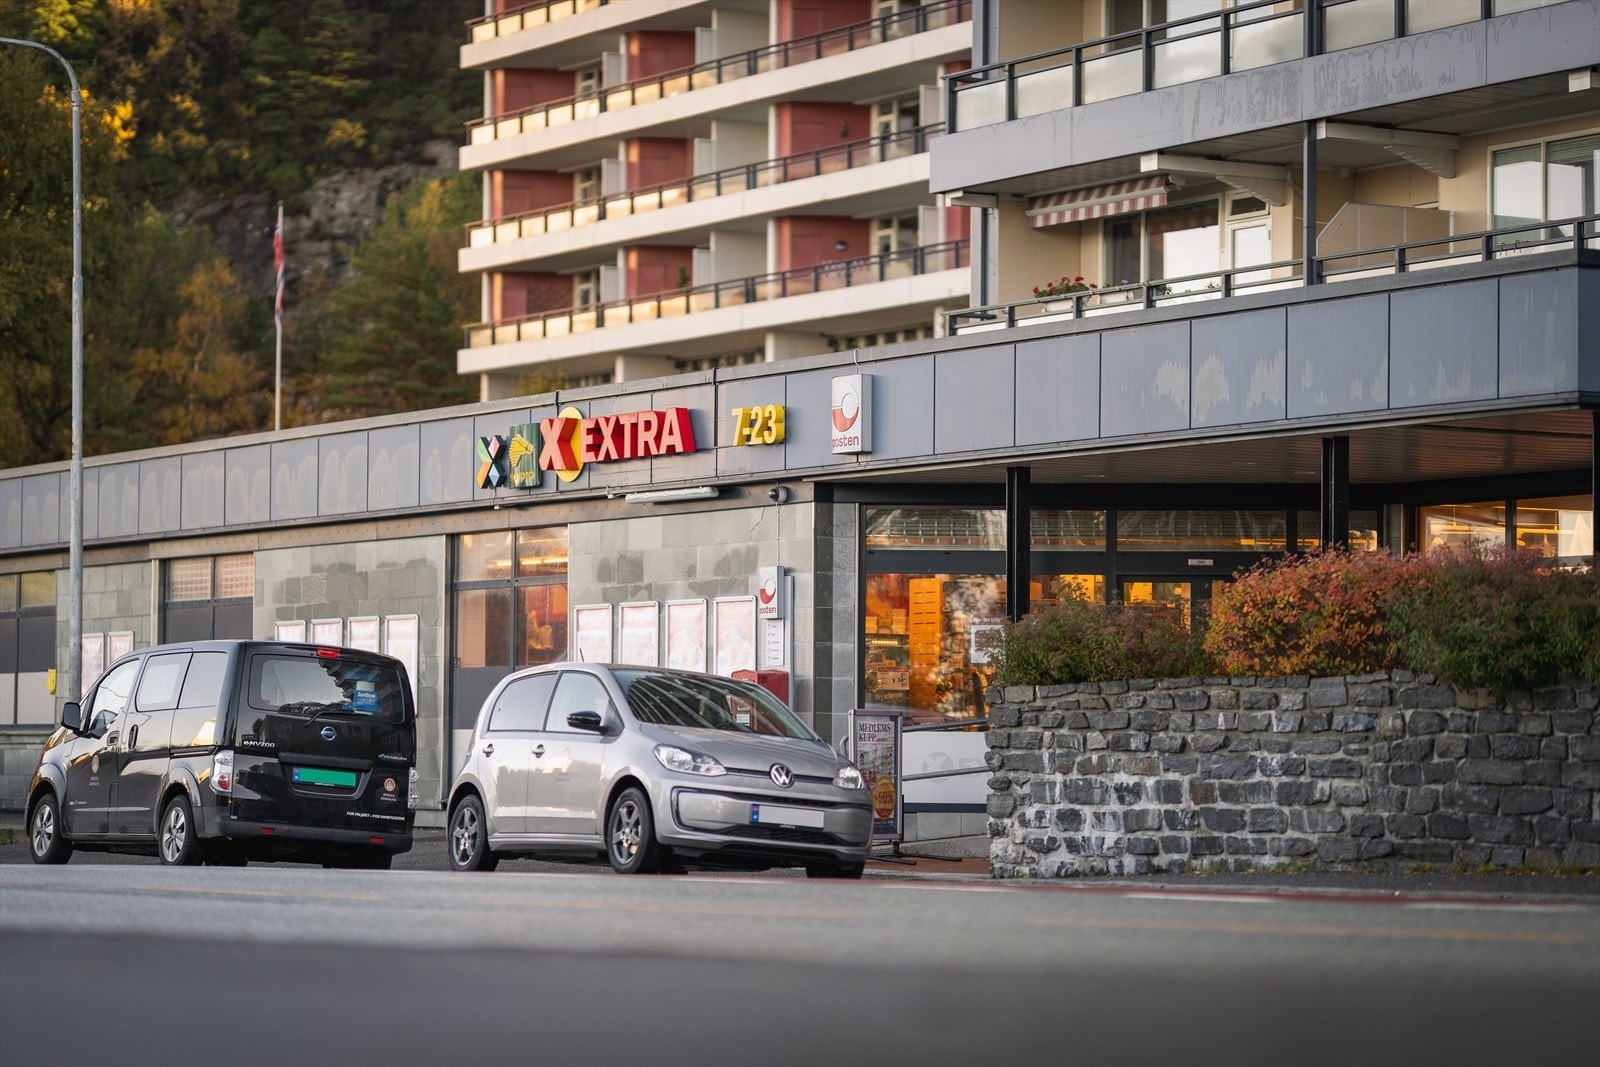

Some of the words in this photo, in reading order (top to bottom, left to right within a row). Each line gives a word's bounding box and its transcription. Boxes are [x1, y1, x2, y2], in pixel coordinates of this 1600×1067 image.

[580, 407, 692, 463] EXTRA
[731, 405, 783, 446] 7-23
[858, 733, 877, 742] KUPP
